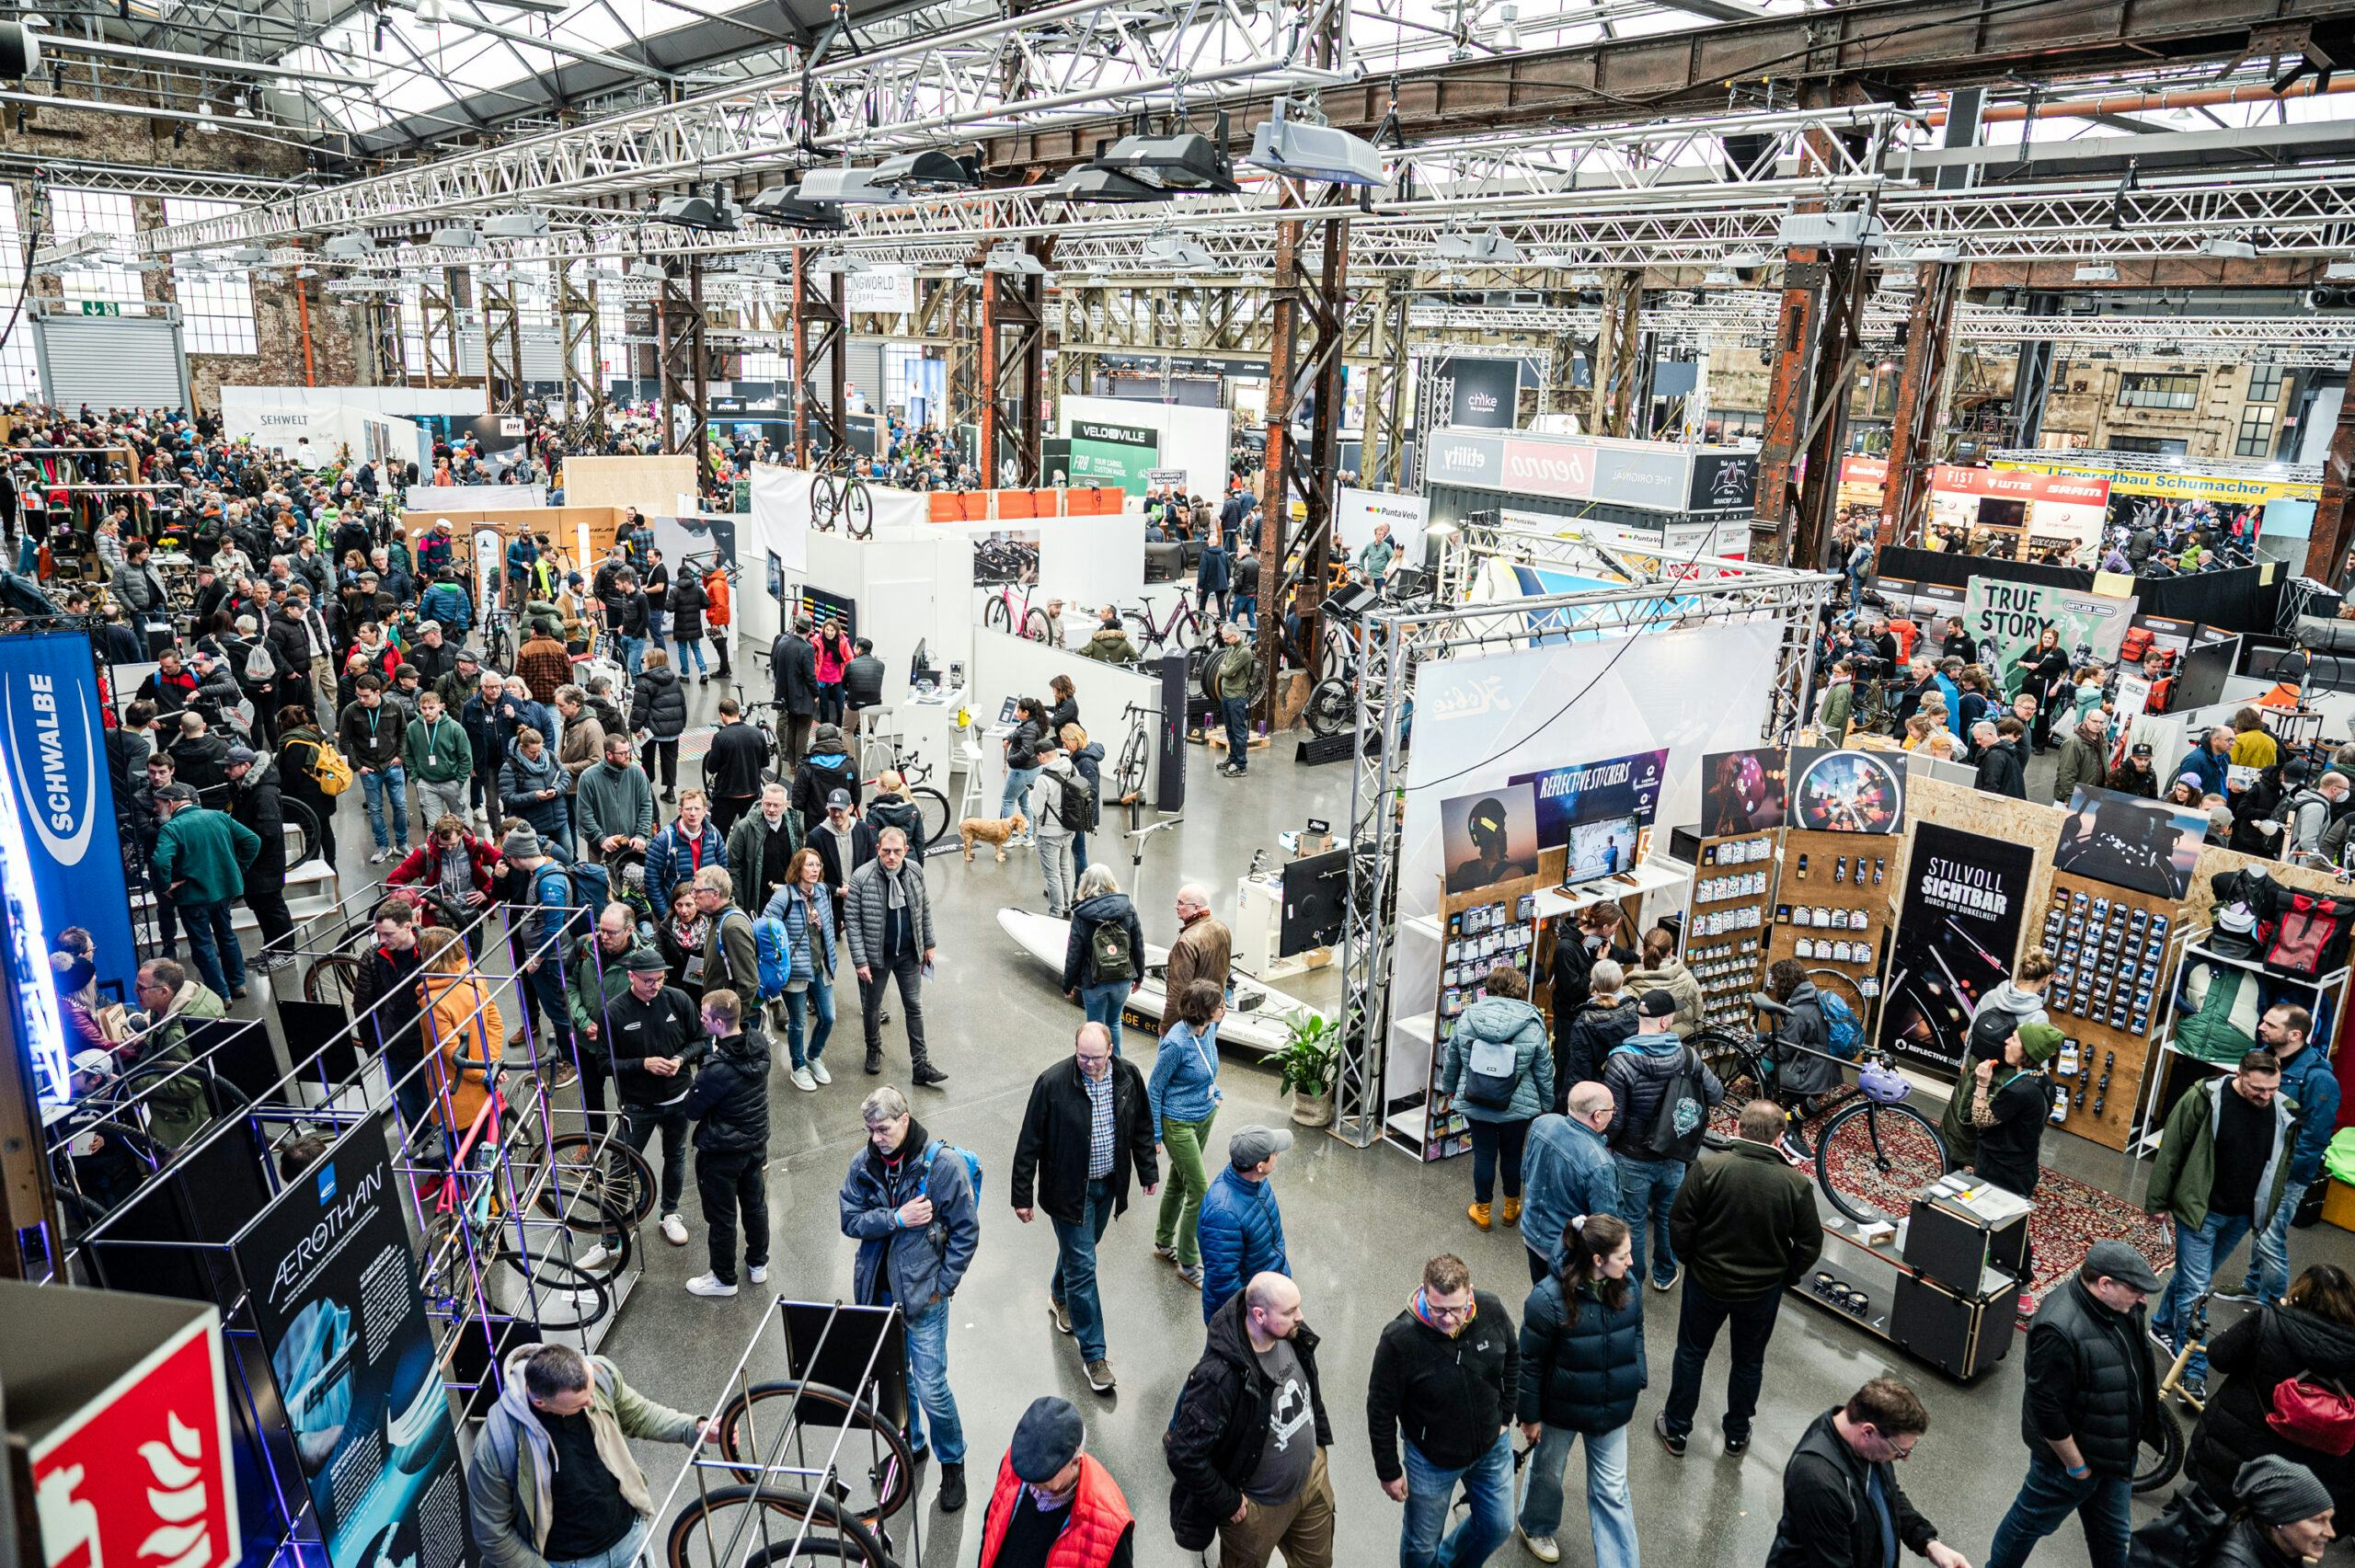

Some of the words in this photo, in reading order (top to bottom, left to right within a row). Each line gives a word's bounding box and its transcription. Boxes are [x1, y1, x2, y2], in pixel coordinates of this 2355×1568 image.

[1468, 392, 1498, 407] chike
[260, 415, 309, 426] SEHWELT
[506, 422, 521, 430] BH
[1947, 470, 1973, 484] FIST
[2155, 475, 2269, 495] Schumacher
[2046, 484, 2103, 498] SRAM
[1381, 507, 1401, 518] Punta
[1402, 510, 1418, 521] Velo
[1984, 585, 2042, 613] TRUE
[1980, 609, 2055, 639] STORY
[29, 673, 75, 832] SCHWALBE
[1539, 771, 1591, 799] REFLECTIVE
[1590, 761, 1632, 790] STICKERS
[1928, 856, 2003, 893] STILVOLL
[1921, 875, 2007, 915] SICHTBAR
[1924, 896, 1945, 908] DURCH
[1946, 901, 1957, 911] DIE
[1959, 905, 1997, 922] DUNKELHEIT
[1120, 1012, 1139, 1027] AGE
[1144, 1023, 1157, 1033] ec
[1908, 1045, 1948, 1063] REFLECTIVE
